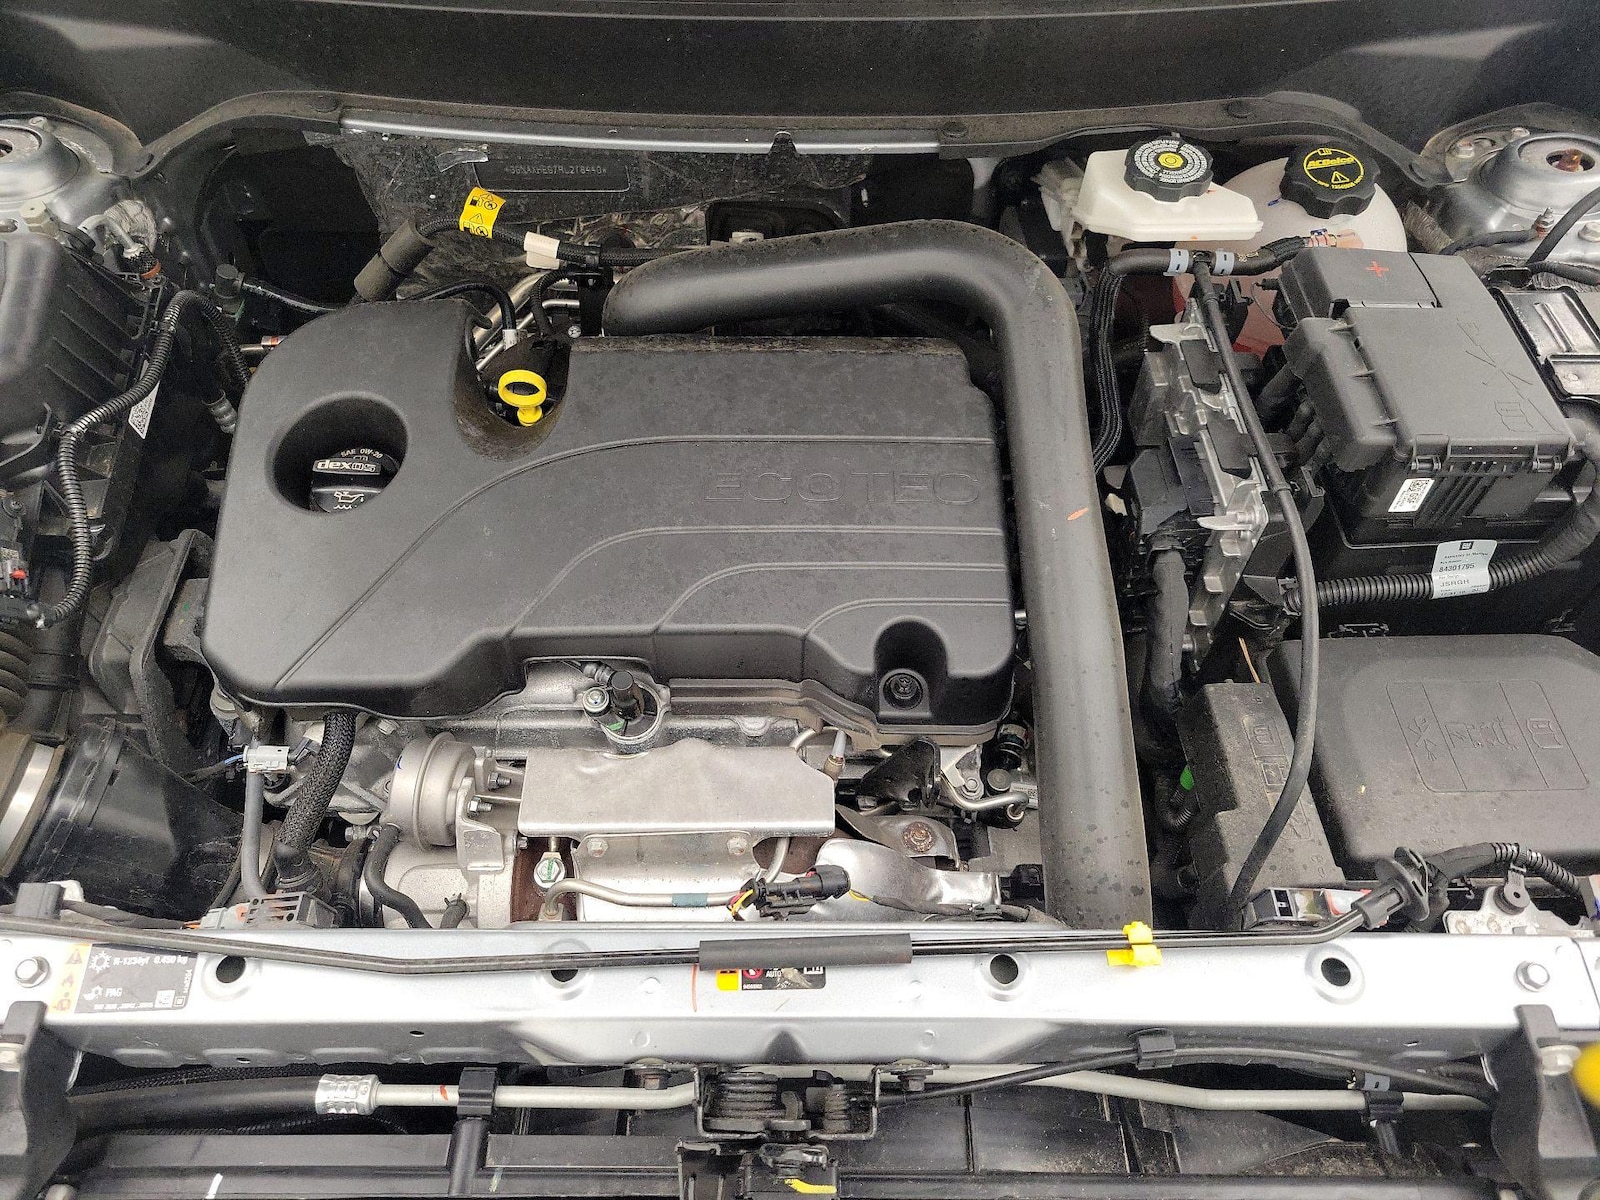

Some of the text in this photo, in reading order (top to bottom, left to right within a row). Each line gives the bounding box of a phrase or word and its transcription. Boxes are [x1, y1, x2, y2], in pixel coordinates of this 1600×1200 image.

[1307, 157, 1355, 168] ACDelco
[340, 448, 356, 458] SAE
[317, 460, 376, 472] dexos
[703, 472, 980, 505] ECOTEC
